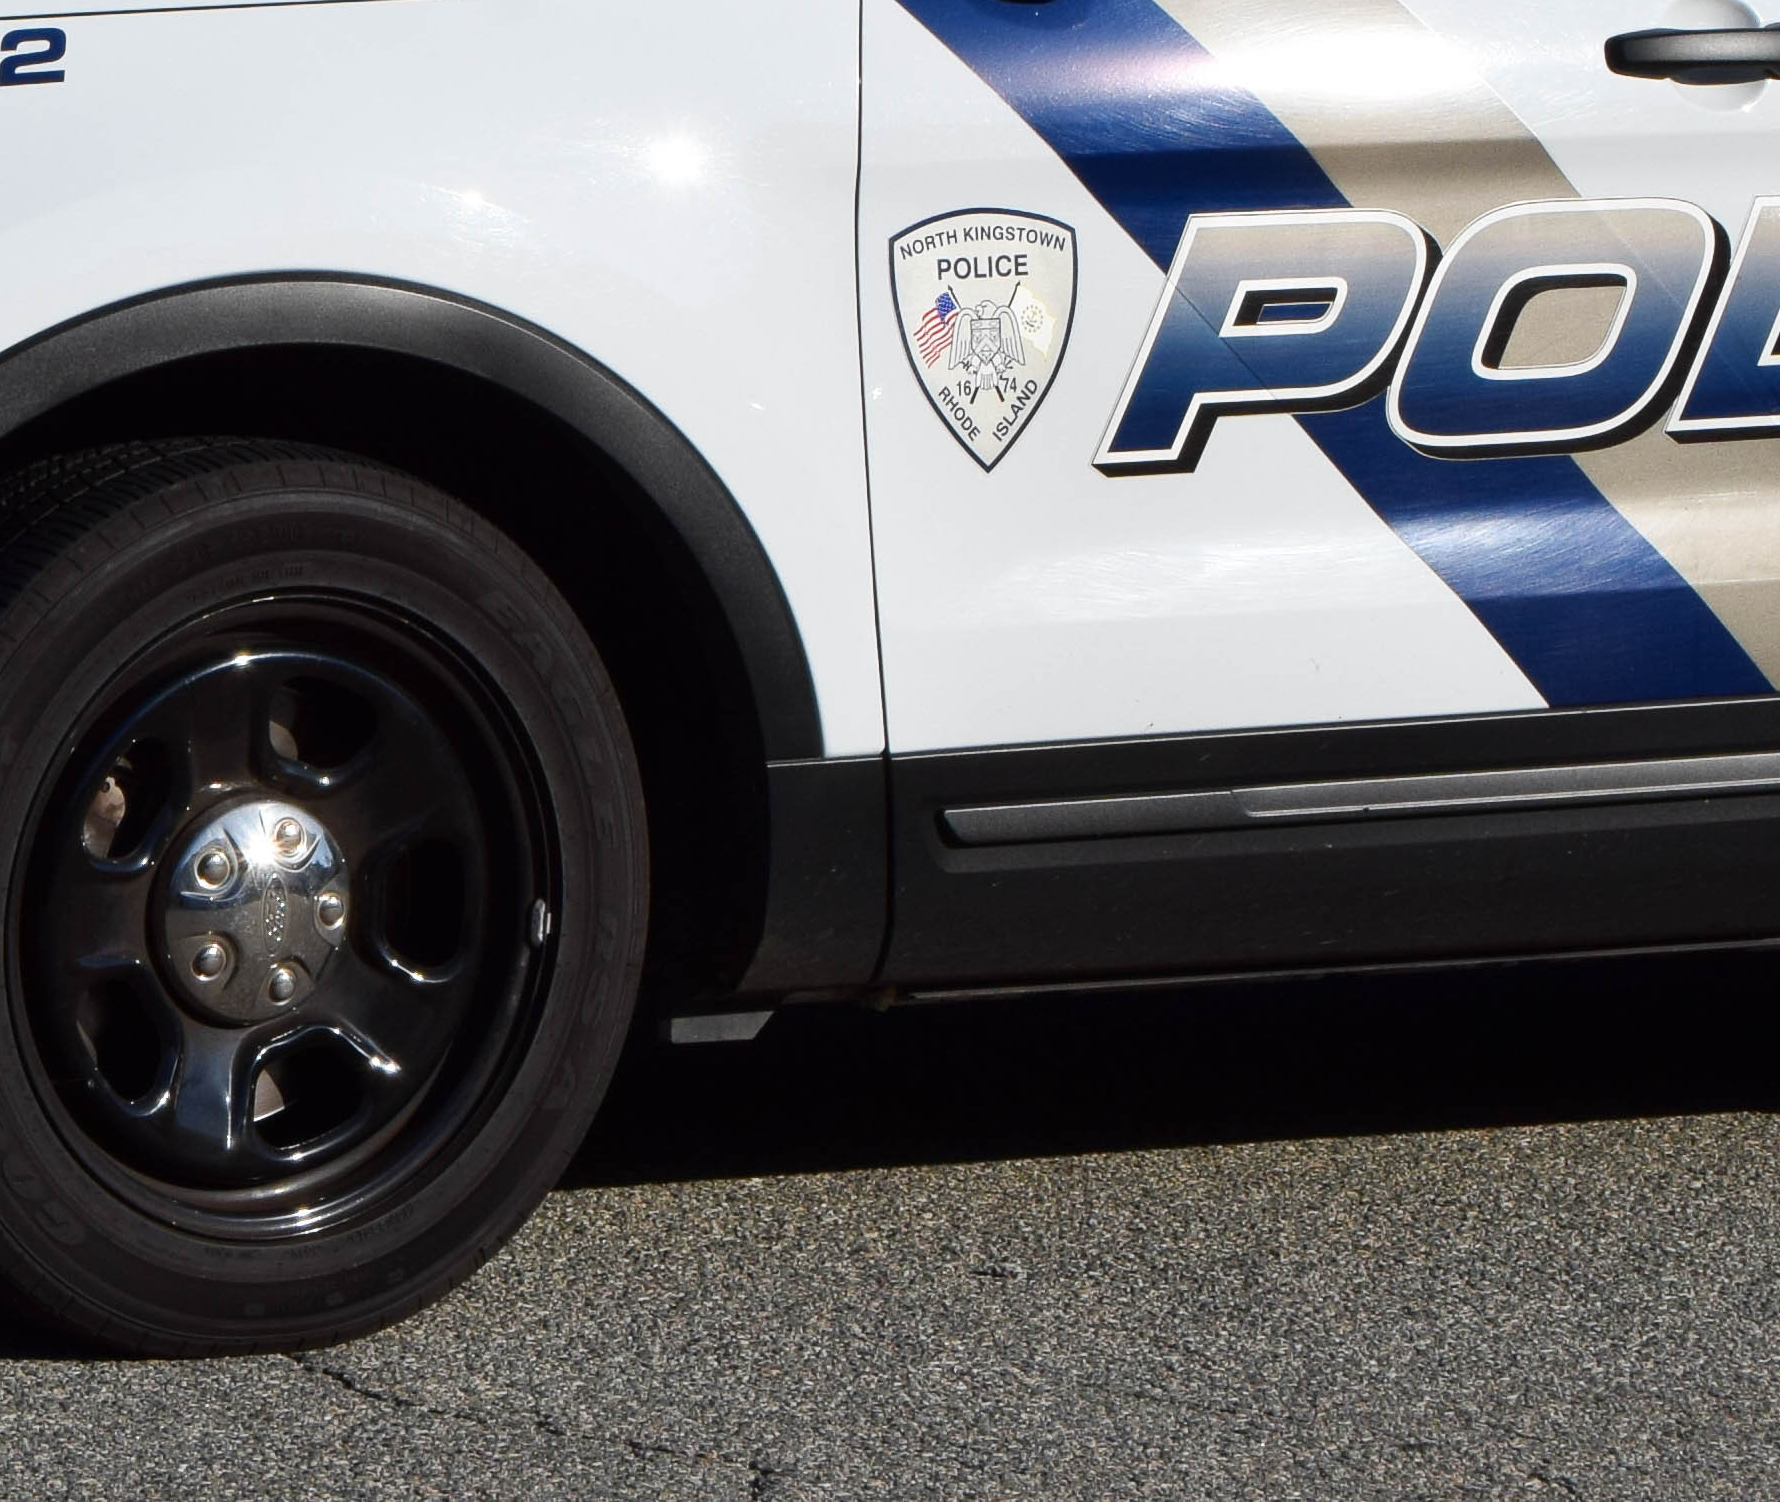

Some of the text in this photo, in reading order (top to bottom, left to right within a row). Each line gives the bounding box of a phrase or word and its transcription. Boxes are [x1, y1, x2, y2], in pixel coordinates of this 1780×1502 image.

[899, 225, 1066, 260] NORTH KINGSTOWN
[937, 254, 1029, 281] POLICE
[956, 378, 1017, 397] 16 74
[938, 379, 1038, 442] RHODE ISLAND
